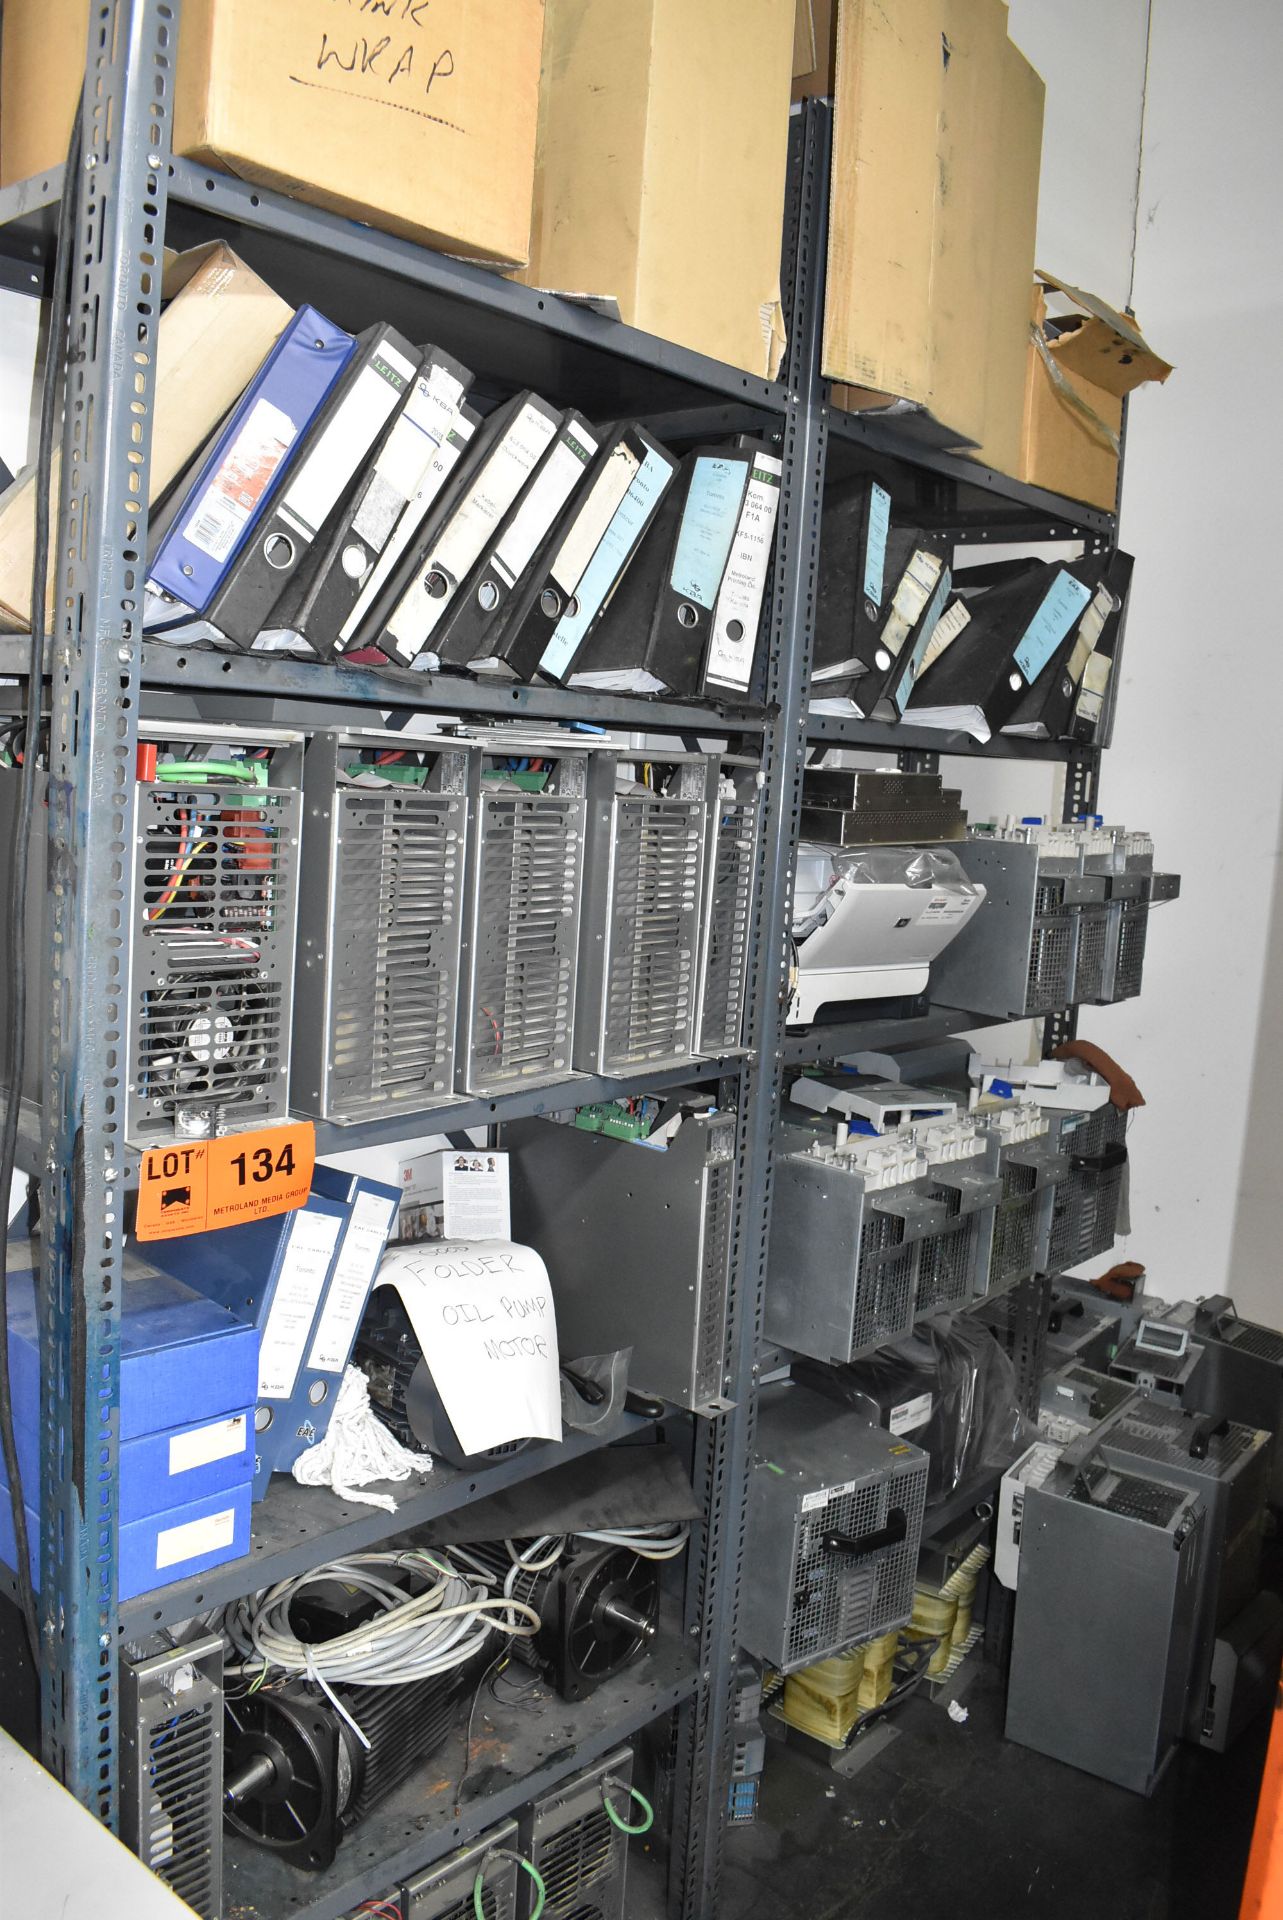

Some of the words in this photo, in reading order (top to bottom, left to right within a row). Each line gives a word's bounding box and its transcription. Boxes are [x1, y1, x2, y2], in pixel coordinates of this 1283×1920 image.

[317, 33, 455, 95] WRAP
[112, 328, 125, 381] CANADA
[373, 358, 404, 388] LEITZ
[566, 437, 587, 460] LEITZ
[751, 469, 774, 485] EITZ
[747, 490, 764, 502] Kom
[750, 501, 763, 511] 064
[763, 506, 772, 514] 00
[745, 511, 761, 523] F1A
[739, 552, 753, 563] IBN
[95, 670, 108, 733] TORONTO
[93, 749, 105, 799] CANADA
[229, 1143, 297, 1187] 134
[403, 1168, 413, 1182] 3M
[213, 1198, 260, 1216] METROLAND
[261, 1193, 283, 1207] MEDIA
[285, 1186, 309, 1202] GROUP
[253, 1206, 270, 1216] LTD.
[403, 1254, 525, 1287] FOLDER
[442, 1303, 495, 1326] OIL
[500, 1295, 547, 1319] PUMP
[483, 1334, 549, 1361] MOTOR
[296, 1426, 316, 1438] EAE
